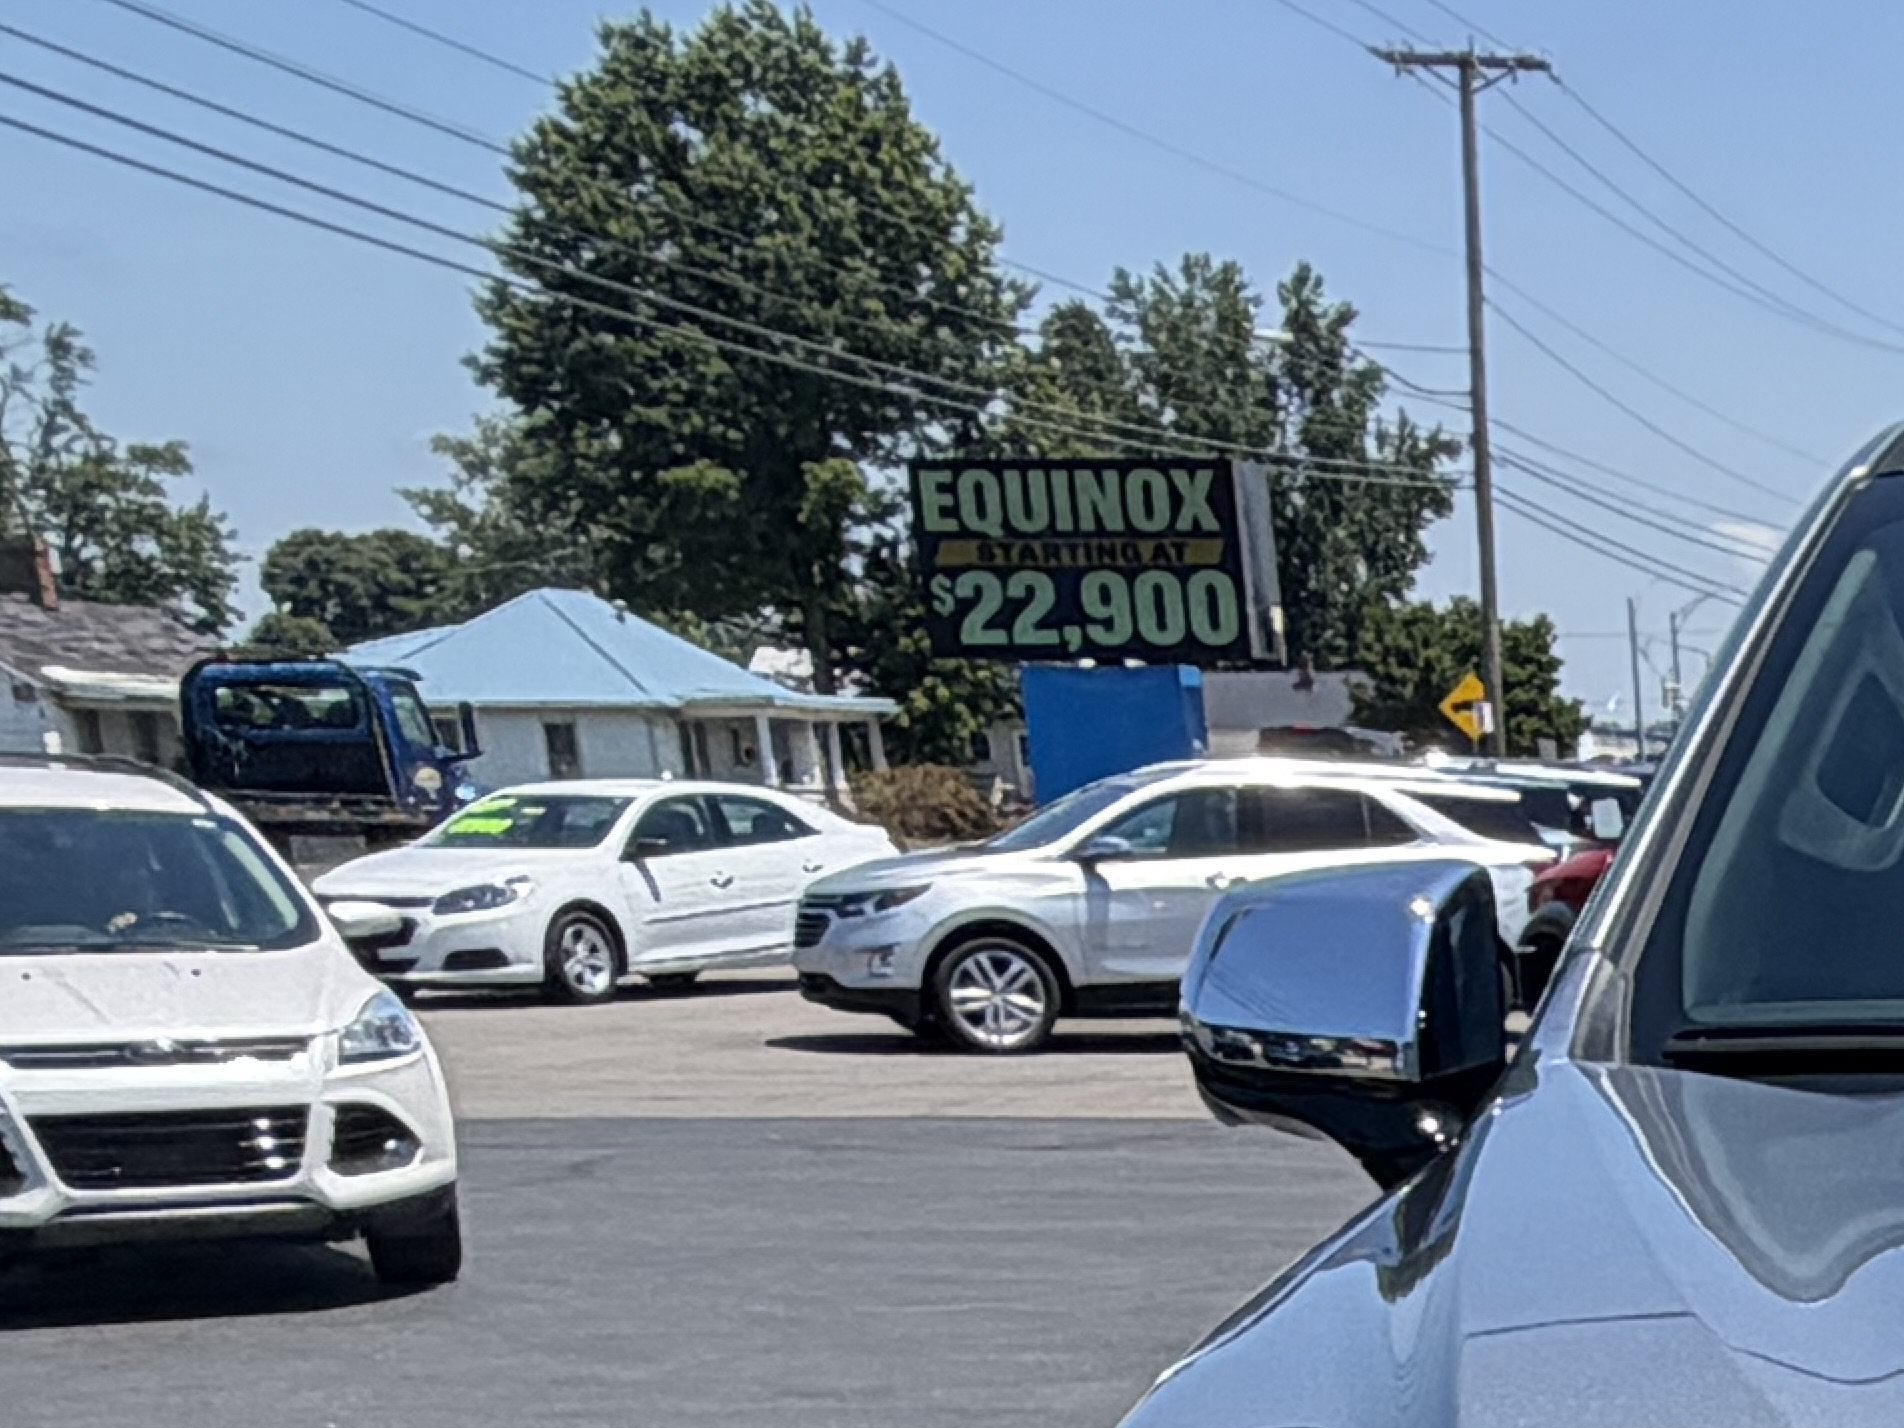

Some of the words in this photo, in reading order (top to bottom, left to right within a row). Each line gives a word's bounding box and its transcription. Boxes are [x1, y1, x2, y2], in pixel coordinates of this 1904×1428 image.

[918, 468, 1220, 537] EQUINOX
[977, 541, 1140, 564] STARTING
[1148, 541, 1188, 563] AT
[930, 569, 1239, 652] $22,900
